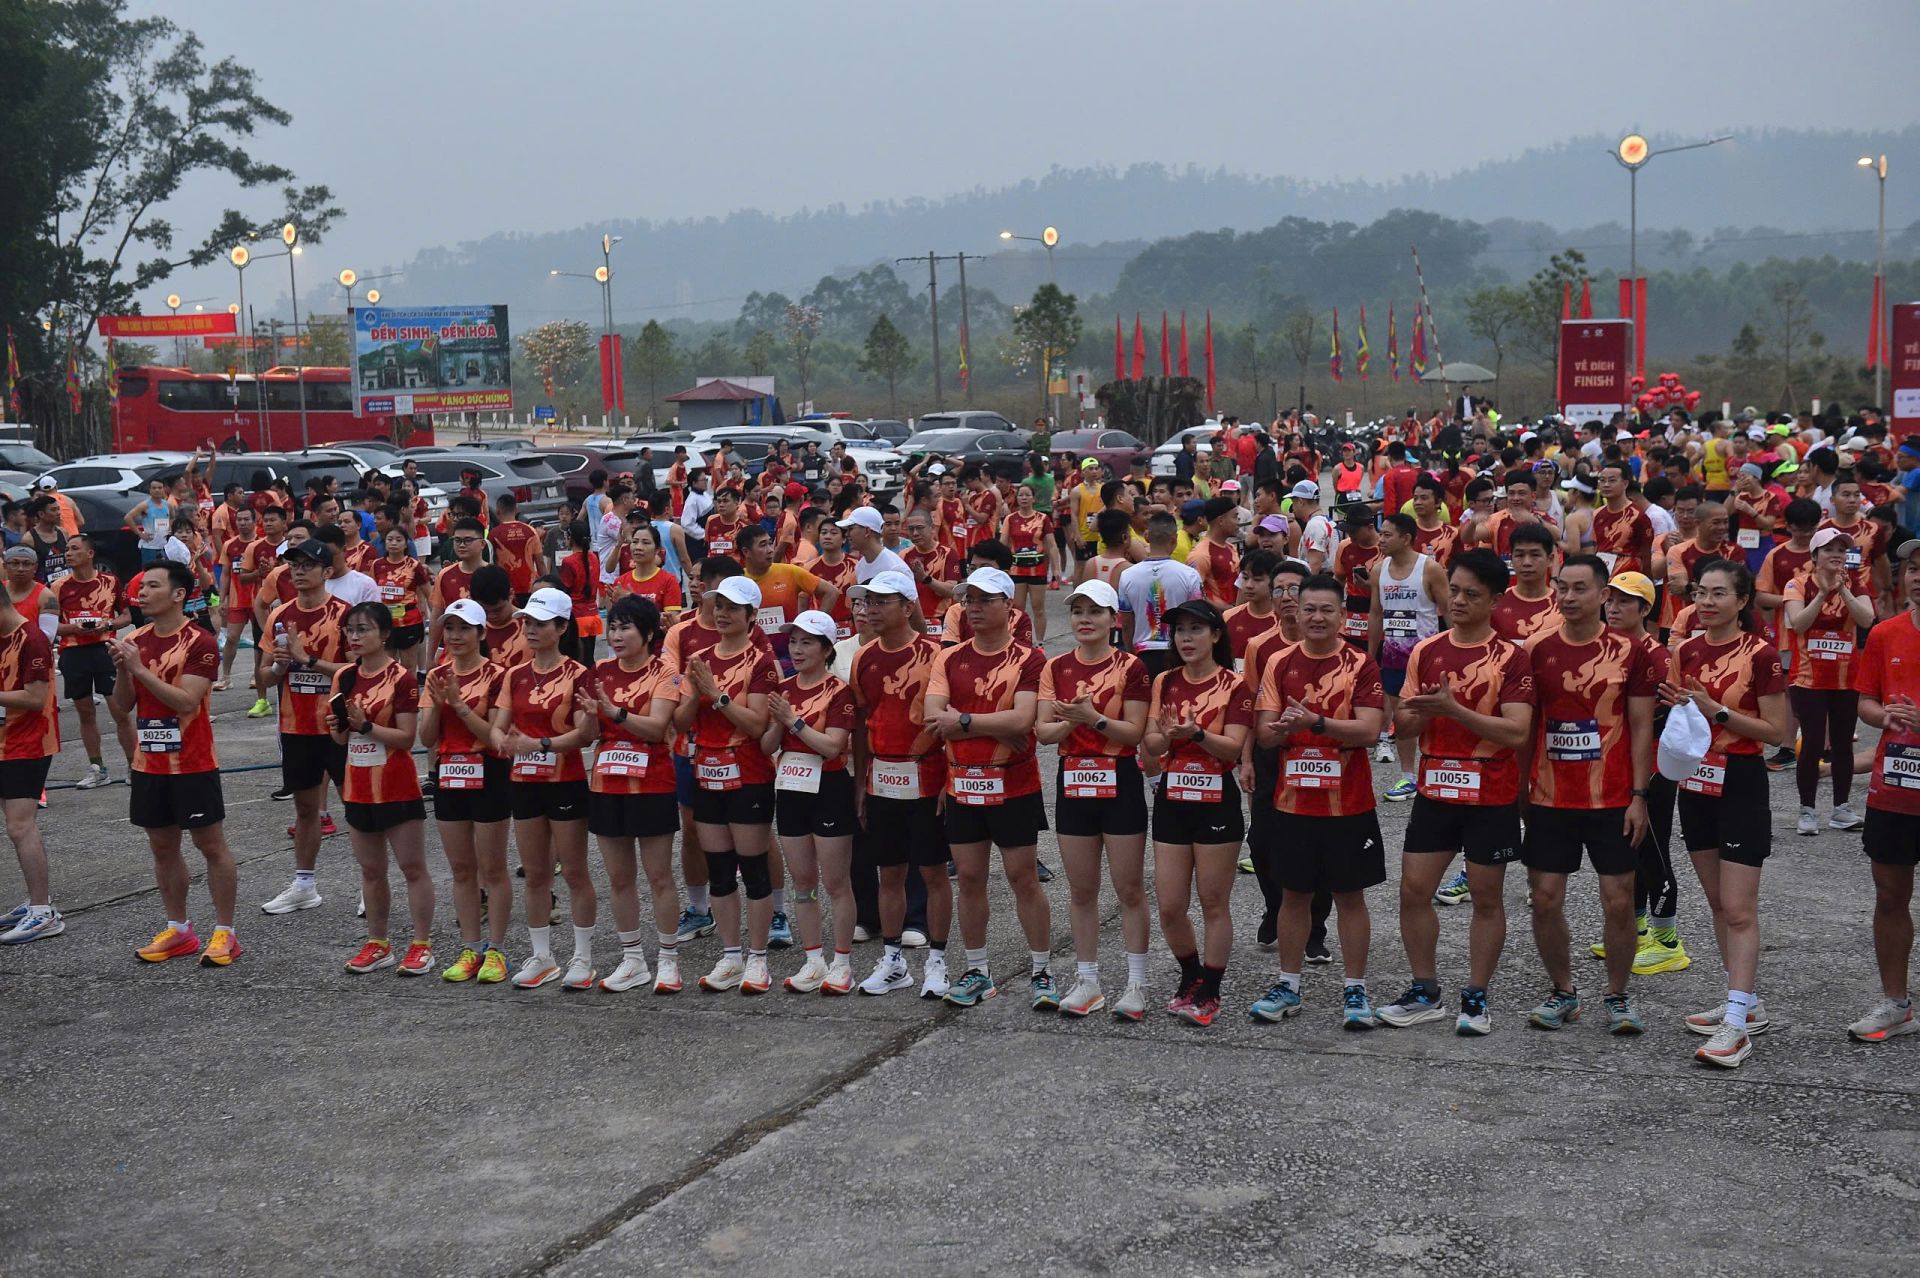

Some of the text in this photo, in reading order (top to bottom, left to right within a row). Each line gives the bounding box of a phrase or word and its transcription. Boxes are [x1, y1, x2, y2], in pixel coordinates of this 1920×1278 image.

[399, 327, 432, 340] SINH
[1574, 375, 1615, 387] FINISH
[1388, 617, 1411, 628] 80202
[1815, 640, 1846, 651] 10127
[294, 673, 323, 684] 80297
[143, 730, 173, 741] 80256
[1552, 734, 1591, 747] 80010
[605, 752, 640, 763] 10066
[444, 765, 475, 776] 10060
[702, 767, 730, 778] 10067
[781, 765, 813, 778] 50027
[1294, 761, 1332, 773] 10056
[877, 773, 910, 786] 50028
[1071, 771, 1107, 783] 10062
[1176, 774, 1213, 787] 10057
[1433, 771, 1470, 785] 10055
[960, 780, 994, 791] 10058
